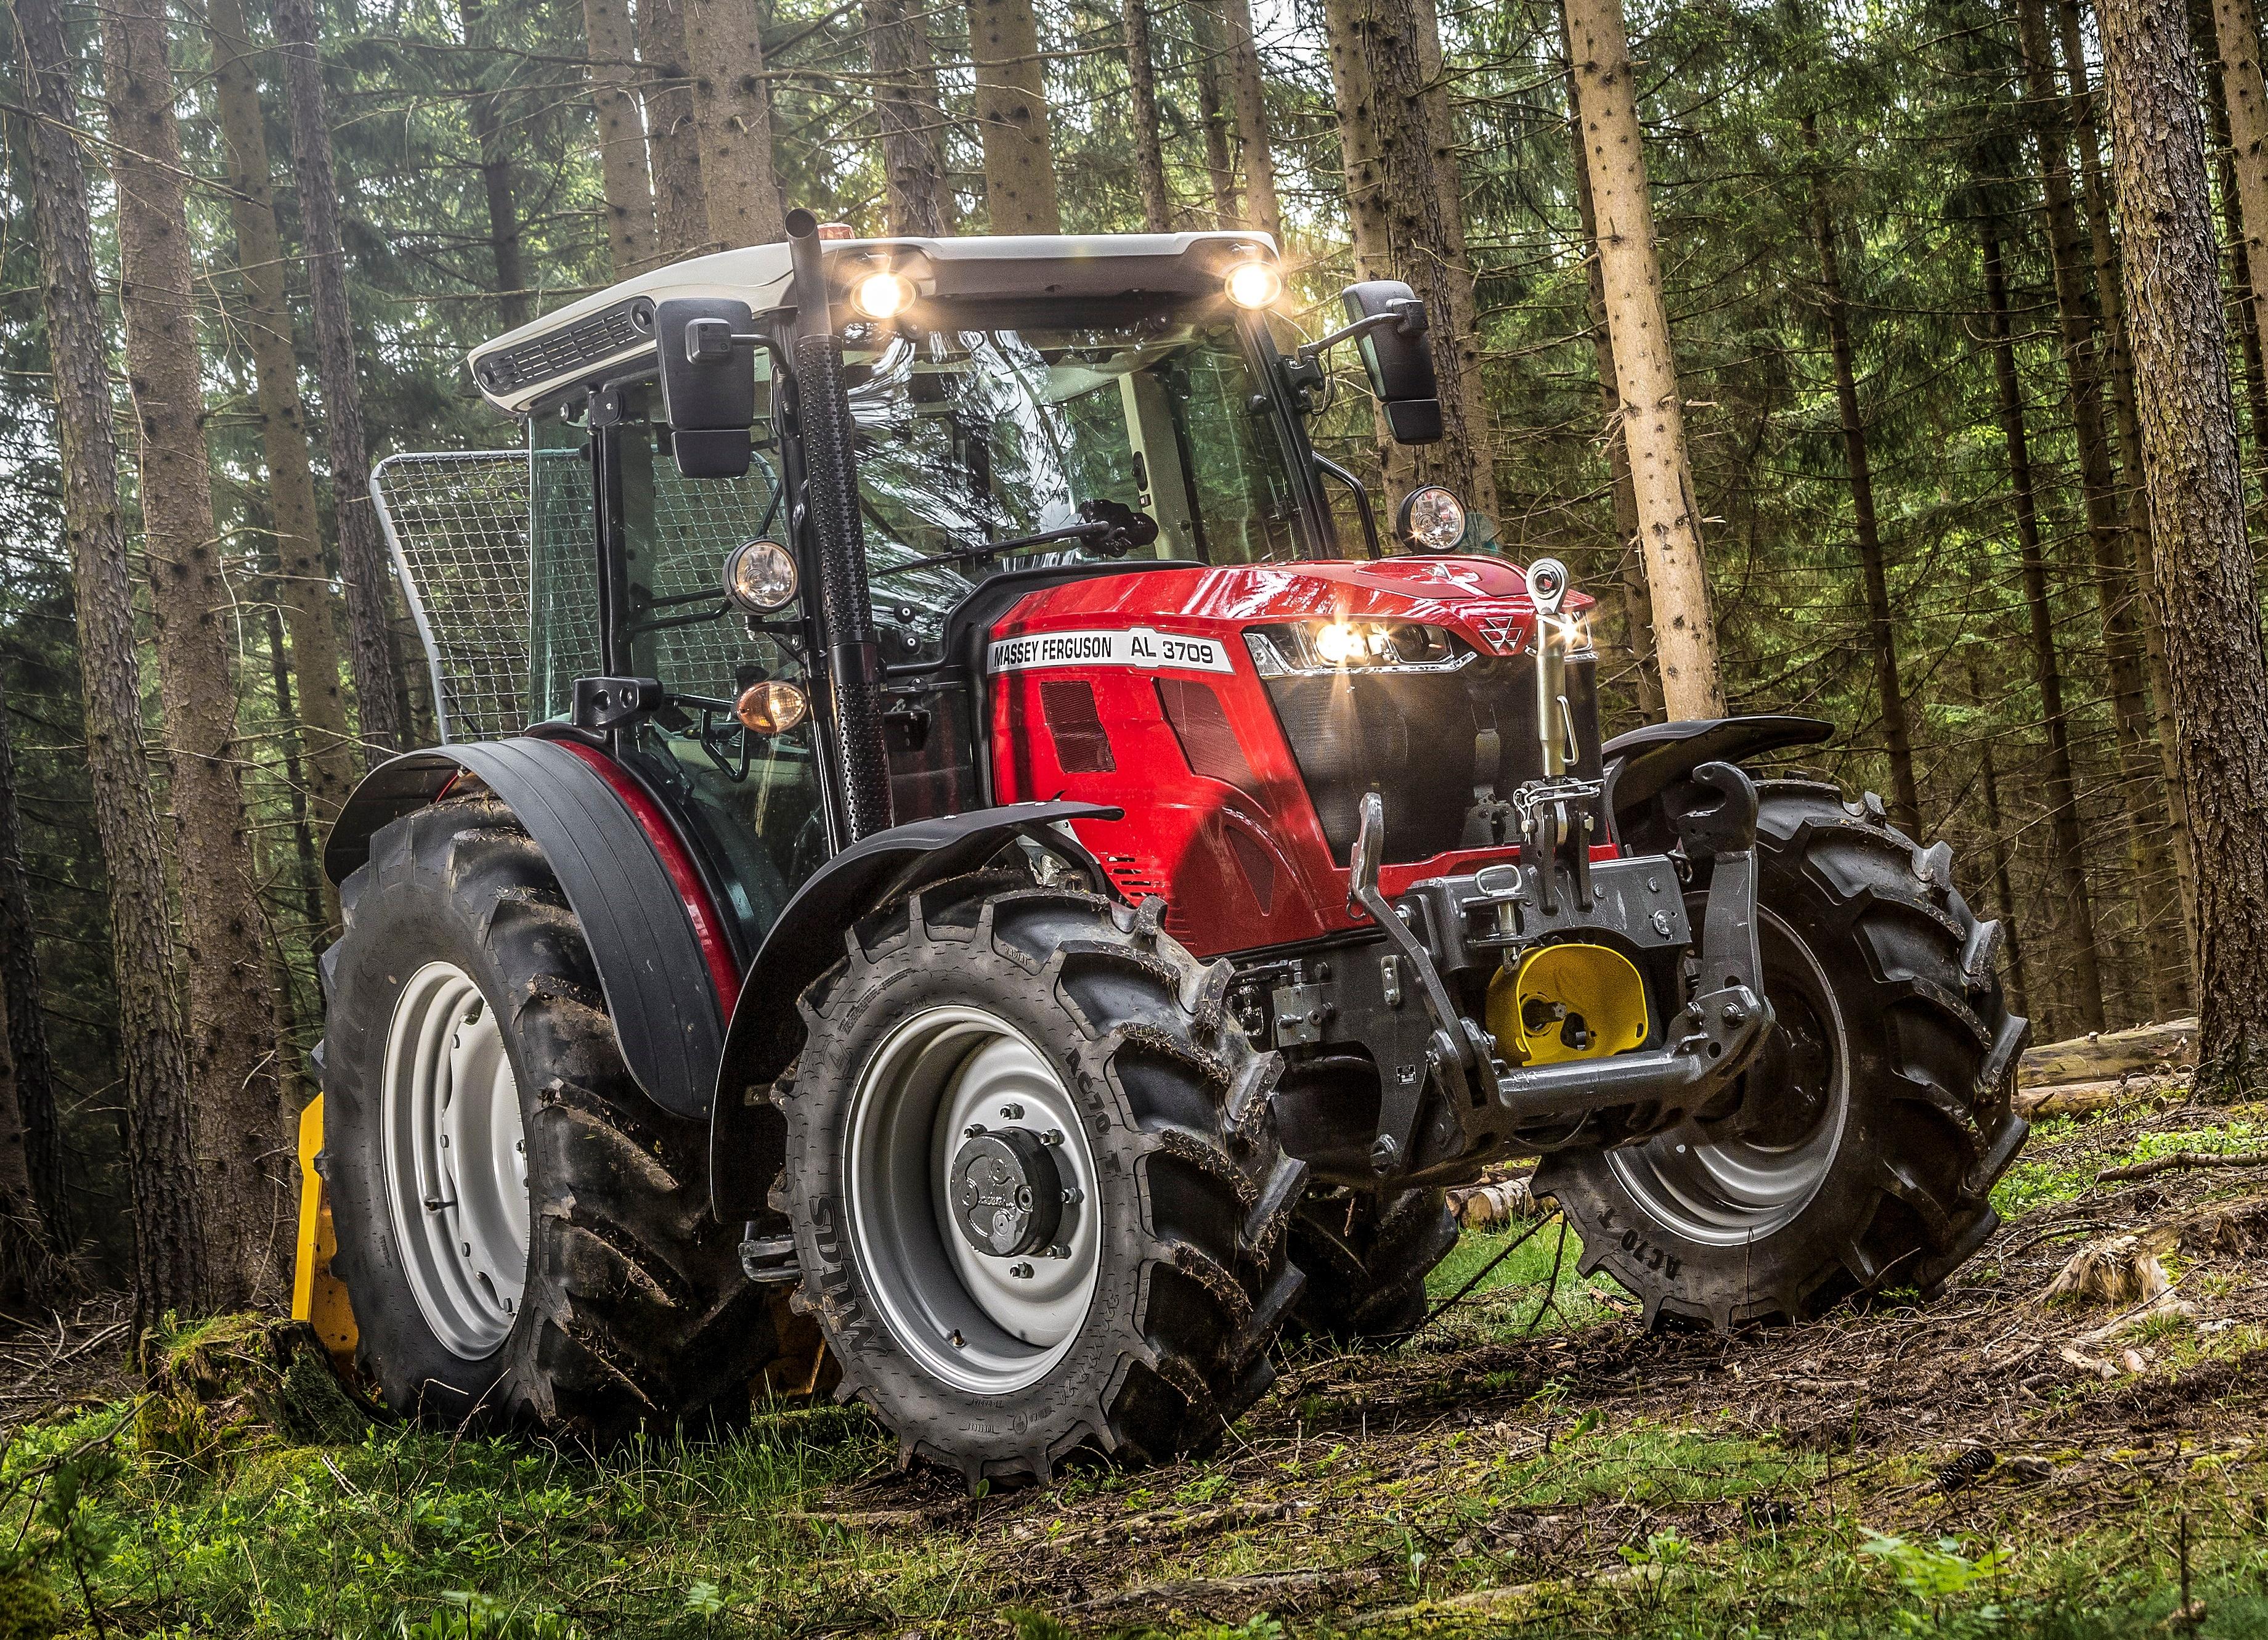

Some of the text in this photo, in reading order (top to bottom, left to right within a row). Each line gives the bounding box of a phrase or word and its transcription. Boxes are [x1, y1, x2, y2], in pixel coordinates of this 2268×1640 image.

[994, 637, 1112, 667] MASSEY FERGUSON
[1131, 636, 1213, 663] AL 3709
[1065, 1048, 1111, 1134] AC70
[1621, 1229, 1681, 1281] AC70
